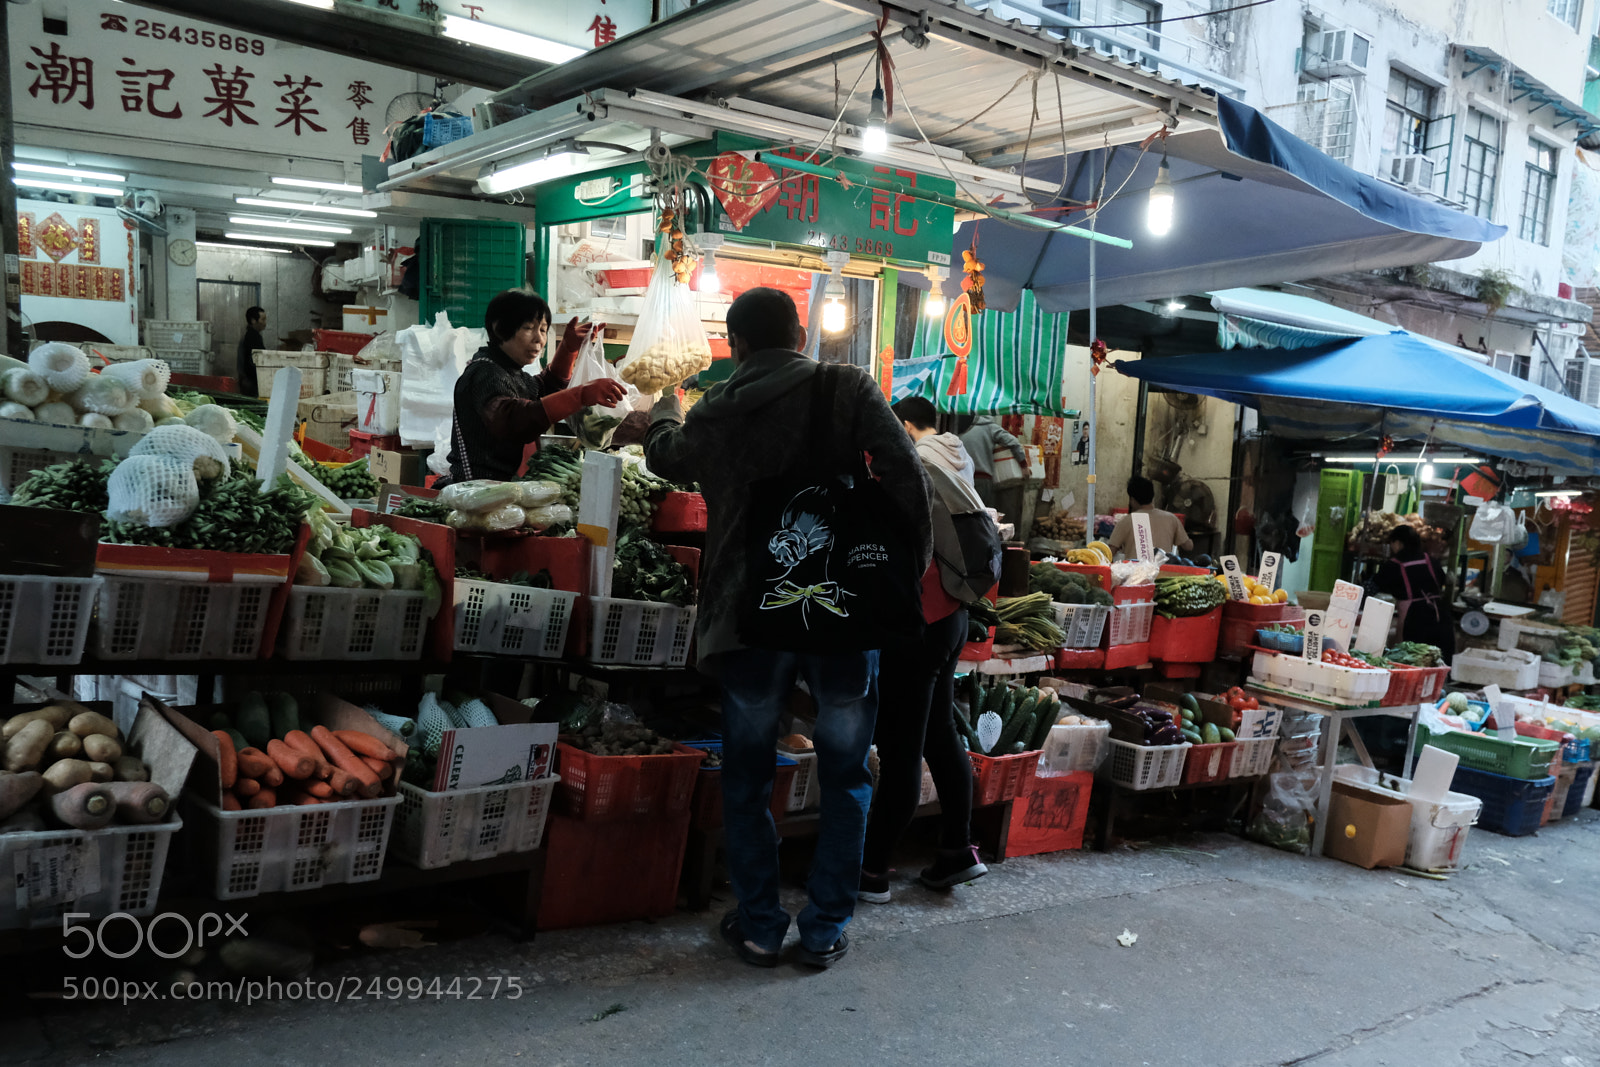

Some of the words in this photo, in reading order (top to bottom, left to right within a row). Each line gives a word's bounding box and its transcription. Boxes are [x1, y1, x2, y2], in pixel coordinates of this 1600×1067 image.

[134, 18, 266, 57] 25435869
[24, 41, 328, 137] 潮記菓菜
[345, 80, 375, 146] 零售
[807, 229, 849, 251] 2543
[855, 237, 894, 257] 5869
[448, 744, 465, 790] CELERY
